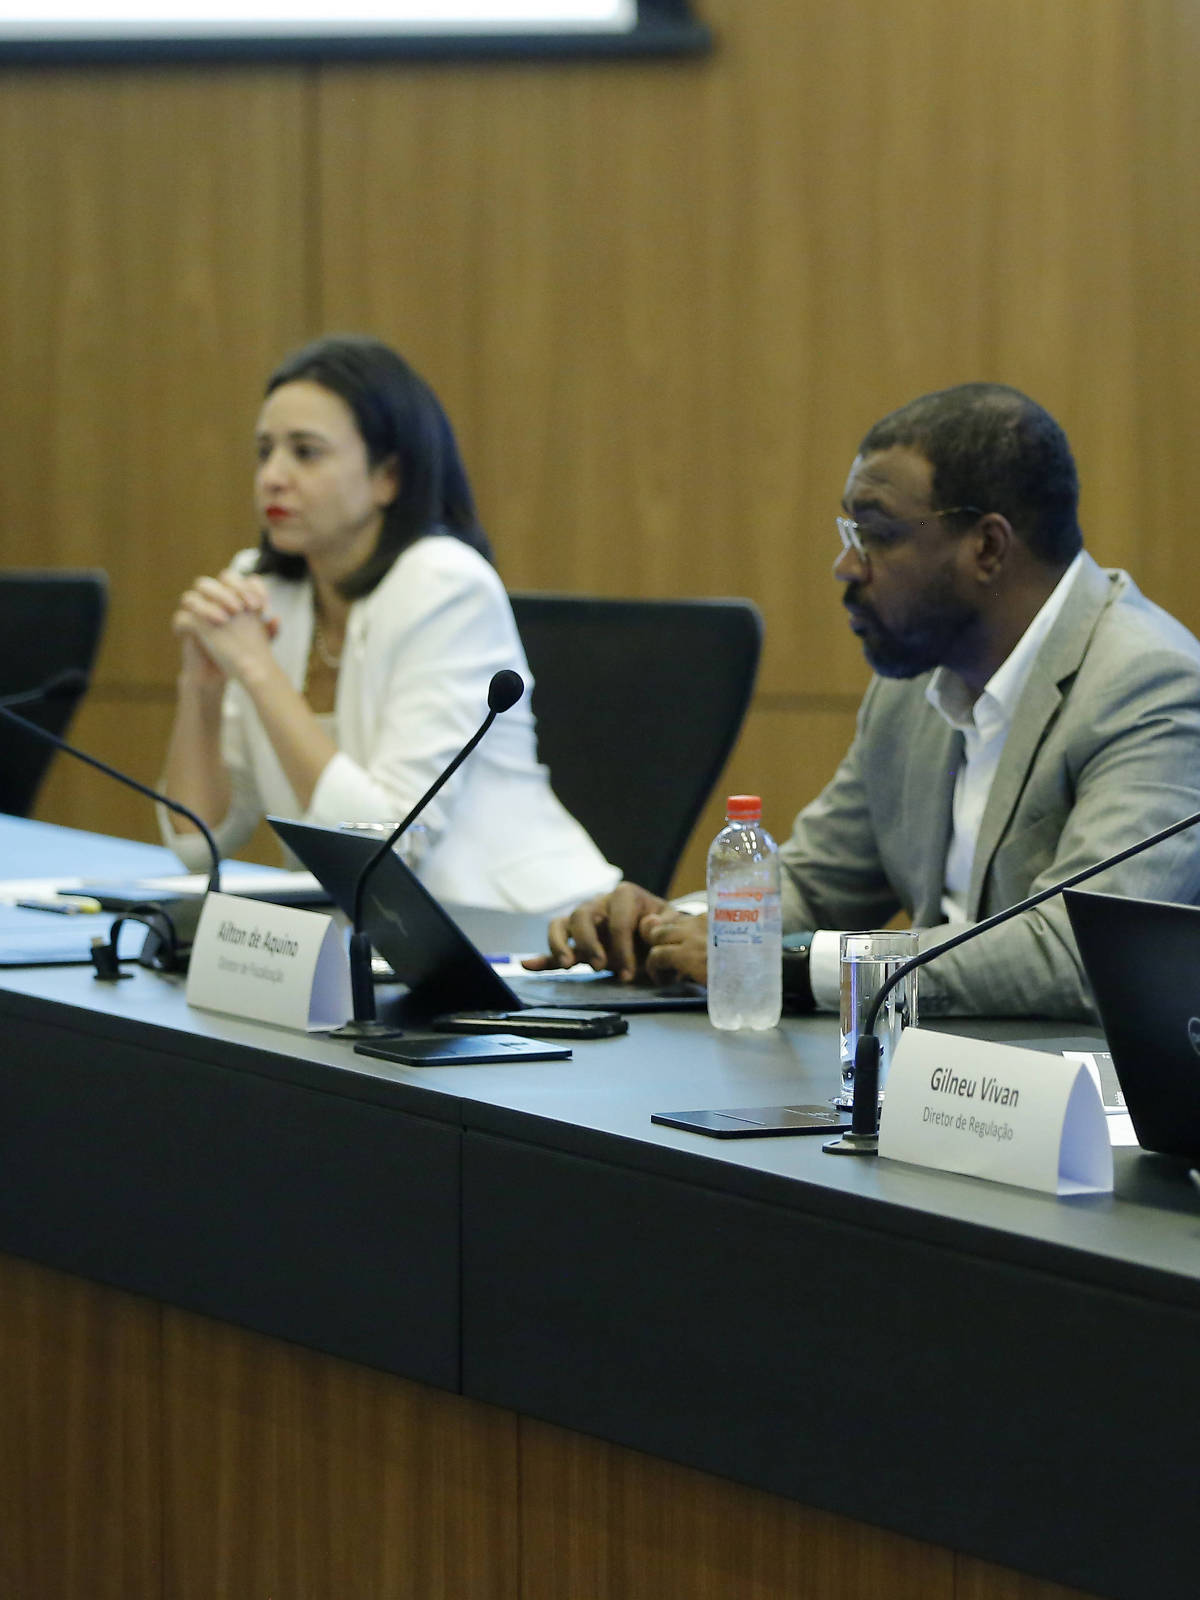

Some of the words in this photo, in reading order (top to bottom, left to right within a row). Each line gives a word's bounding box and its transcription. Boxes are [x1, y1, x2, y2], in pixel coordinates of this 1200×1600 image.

[217, 921, 246, 945] Ailton
[248, 926, 261, 949] de
[264, 931, 299, 957] Aquino
[930, 1066, 977, 1098] Gilneu
[980, 1076, 1020, 1107] Vivan
[923, 1106, 954, 1127] Diretor
[956, 1114, 967, 1131] de
[969, 1116, 1014, 1141] Regulação
